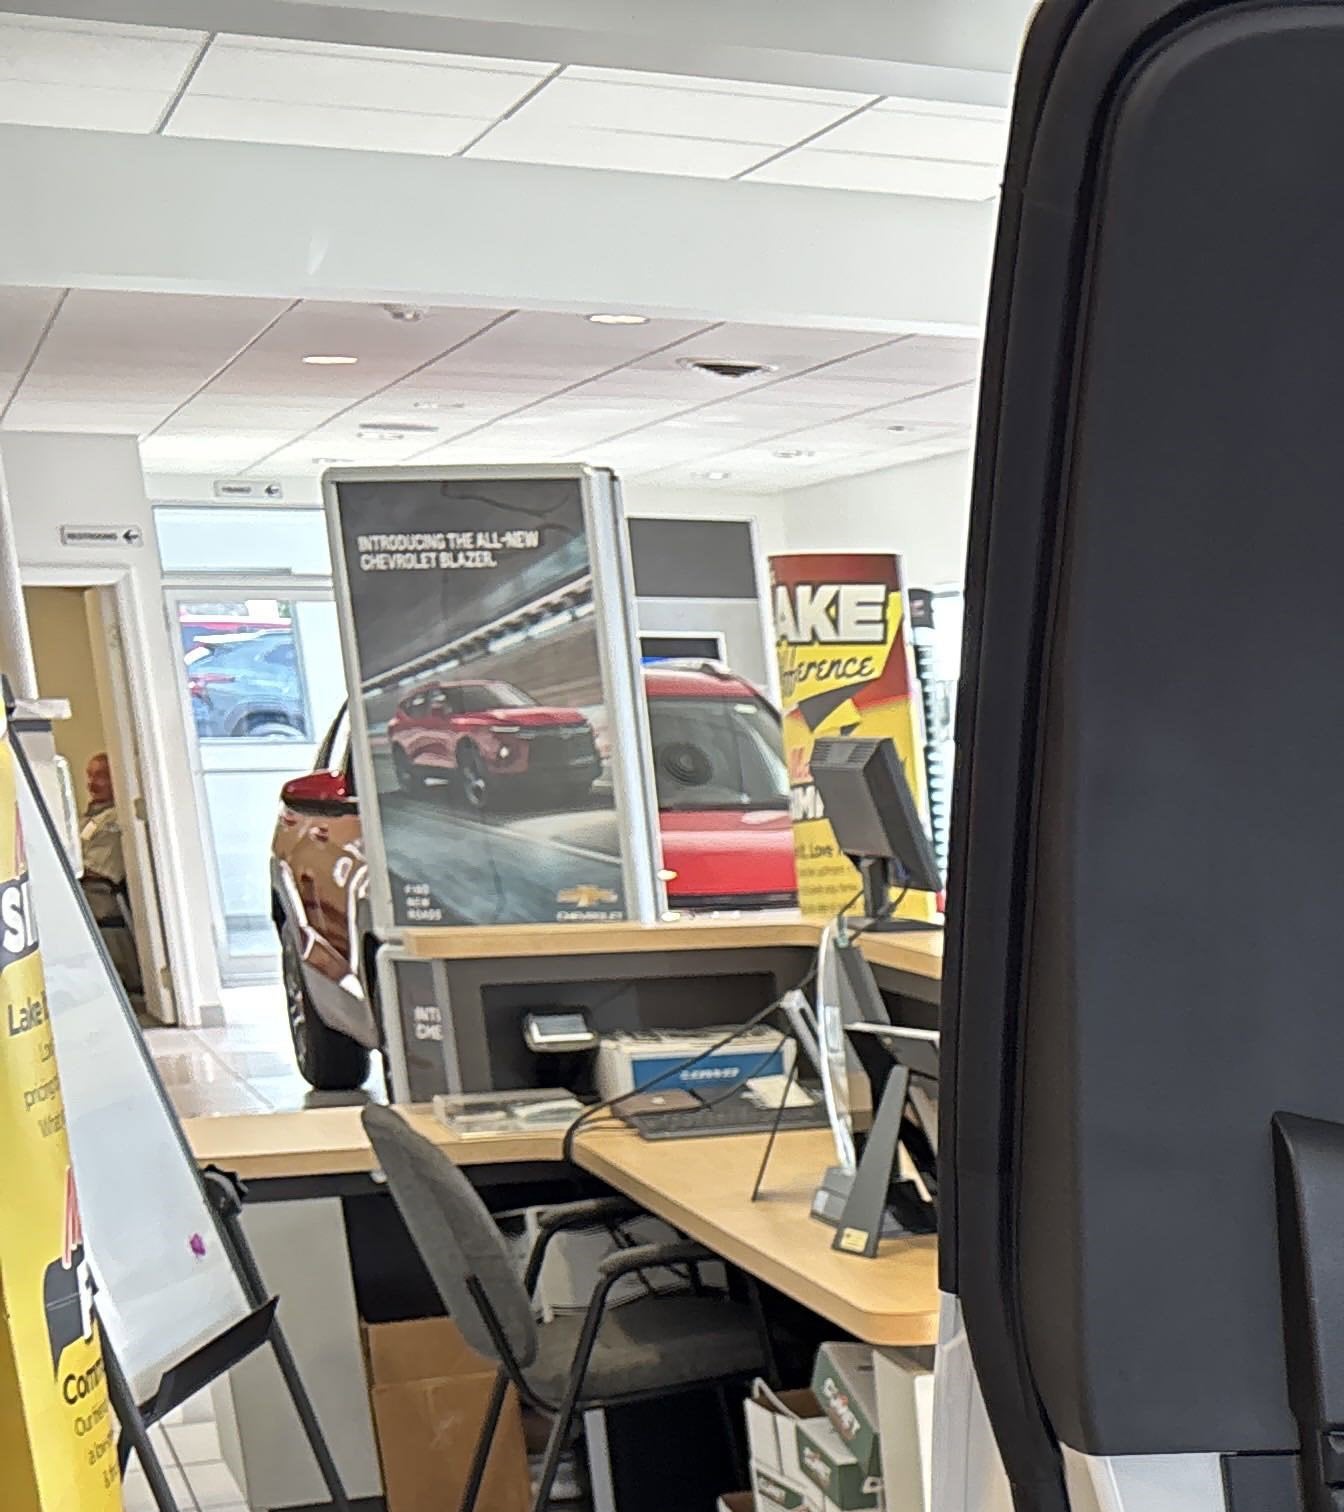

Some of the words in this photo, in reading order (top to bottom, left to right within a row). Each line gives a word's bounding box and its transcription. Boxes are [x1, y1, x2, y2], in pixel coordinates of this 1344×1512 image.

[357, 533, 446, 552] INTRODUCING
[446, 532, 474, 550] THE
[476, 530, 540, 550] ALL-NEW
[359, 551, 437, 571] CHEVROLET
